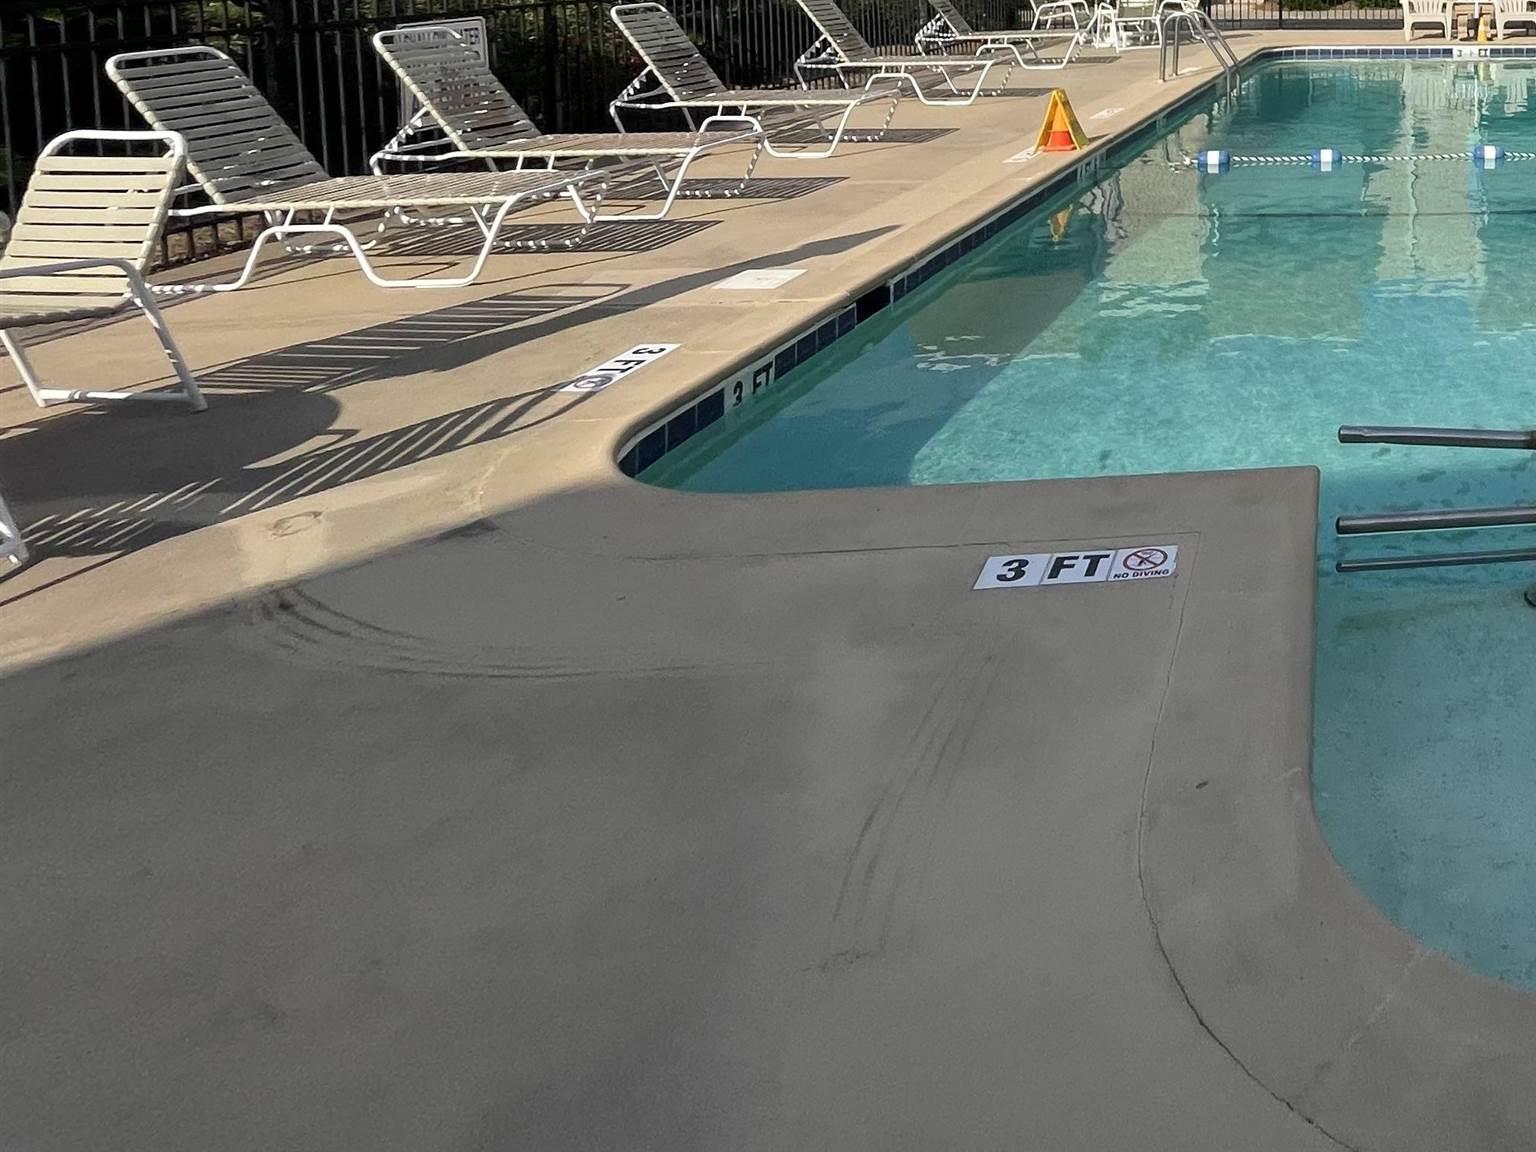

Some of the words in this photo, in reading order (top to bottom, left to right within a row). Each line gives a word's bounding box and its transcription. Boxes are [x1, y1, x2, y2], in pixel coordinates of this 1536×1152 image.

[631, 347, 666, 355] 3
[597, 359, 647, 373] FT
[733, 380, 743, 407] 3
[752, 361, 774, 395] FT
[996, 558, 1029, 582] 3
[1047, 554, 1111, 580] FT
[1132, 568, 1170, 578] DIVING
